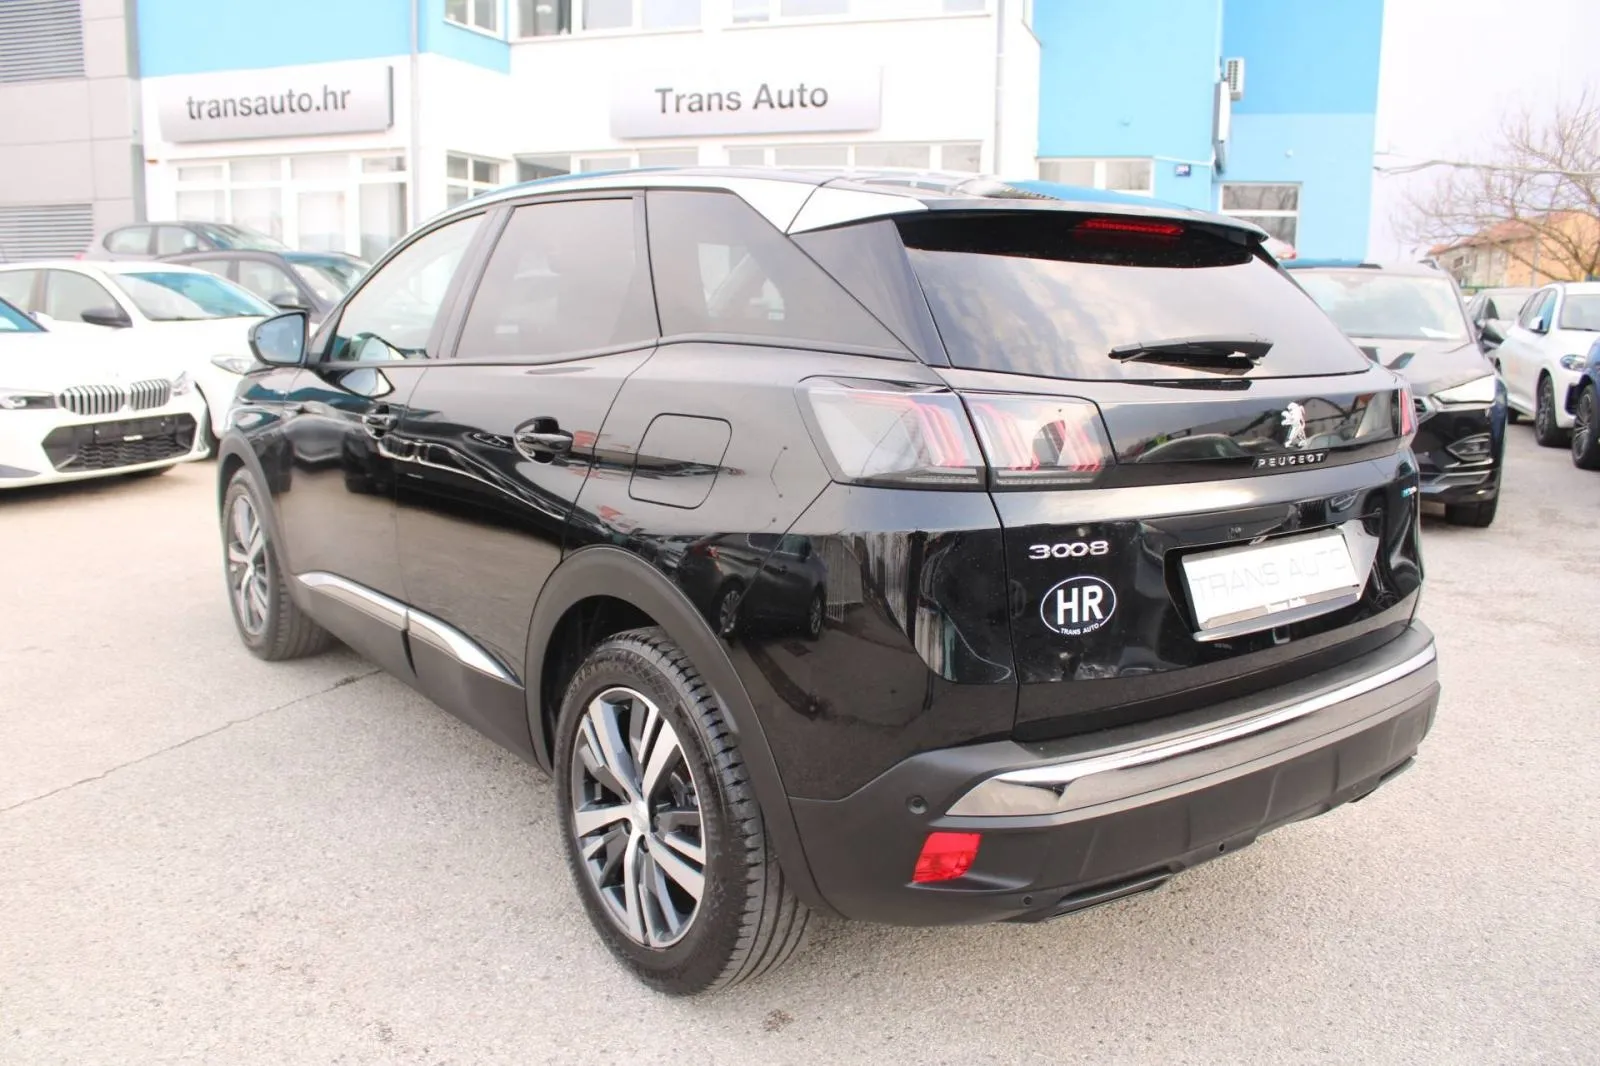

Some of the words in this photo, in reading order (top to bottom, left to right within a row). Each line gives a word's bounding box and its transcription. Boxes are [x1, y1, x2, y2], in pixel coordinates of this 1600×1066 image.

[187, 84, 351, 120] transauto.hr
[654, 87, 742, 114] Trans
[752, 83, 829, 109] Auto
[1257, 452, 1324, 468] PEUGEOT
[1028, 540, 1110, 560] 3008
[1191, 562, 1280, 600] TRANS
[1057, 585, 1103, 625] HR
[1060, 627, 1081, 635] TRANS
[1082, 622, 1100, 634] AUTO
